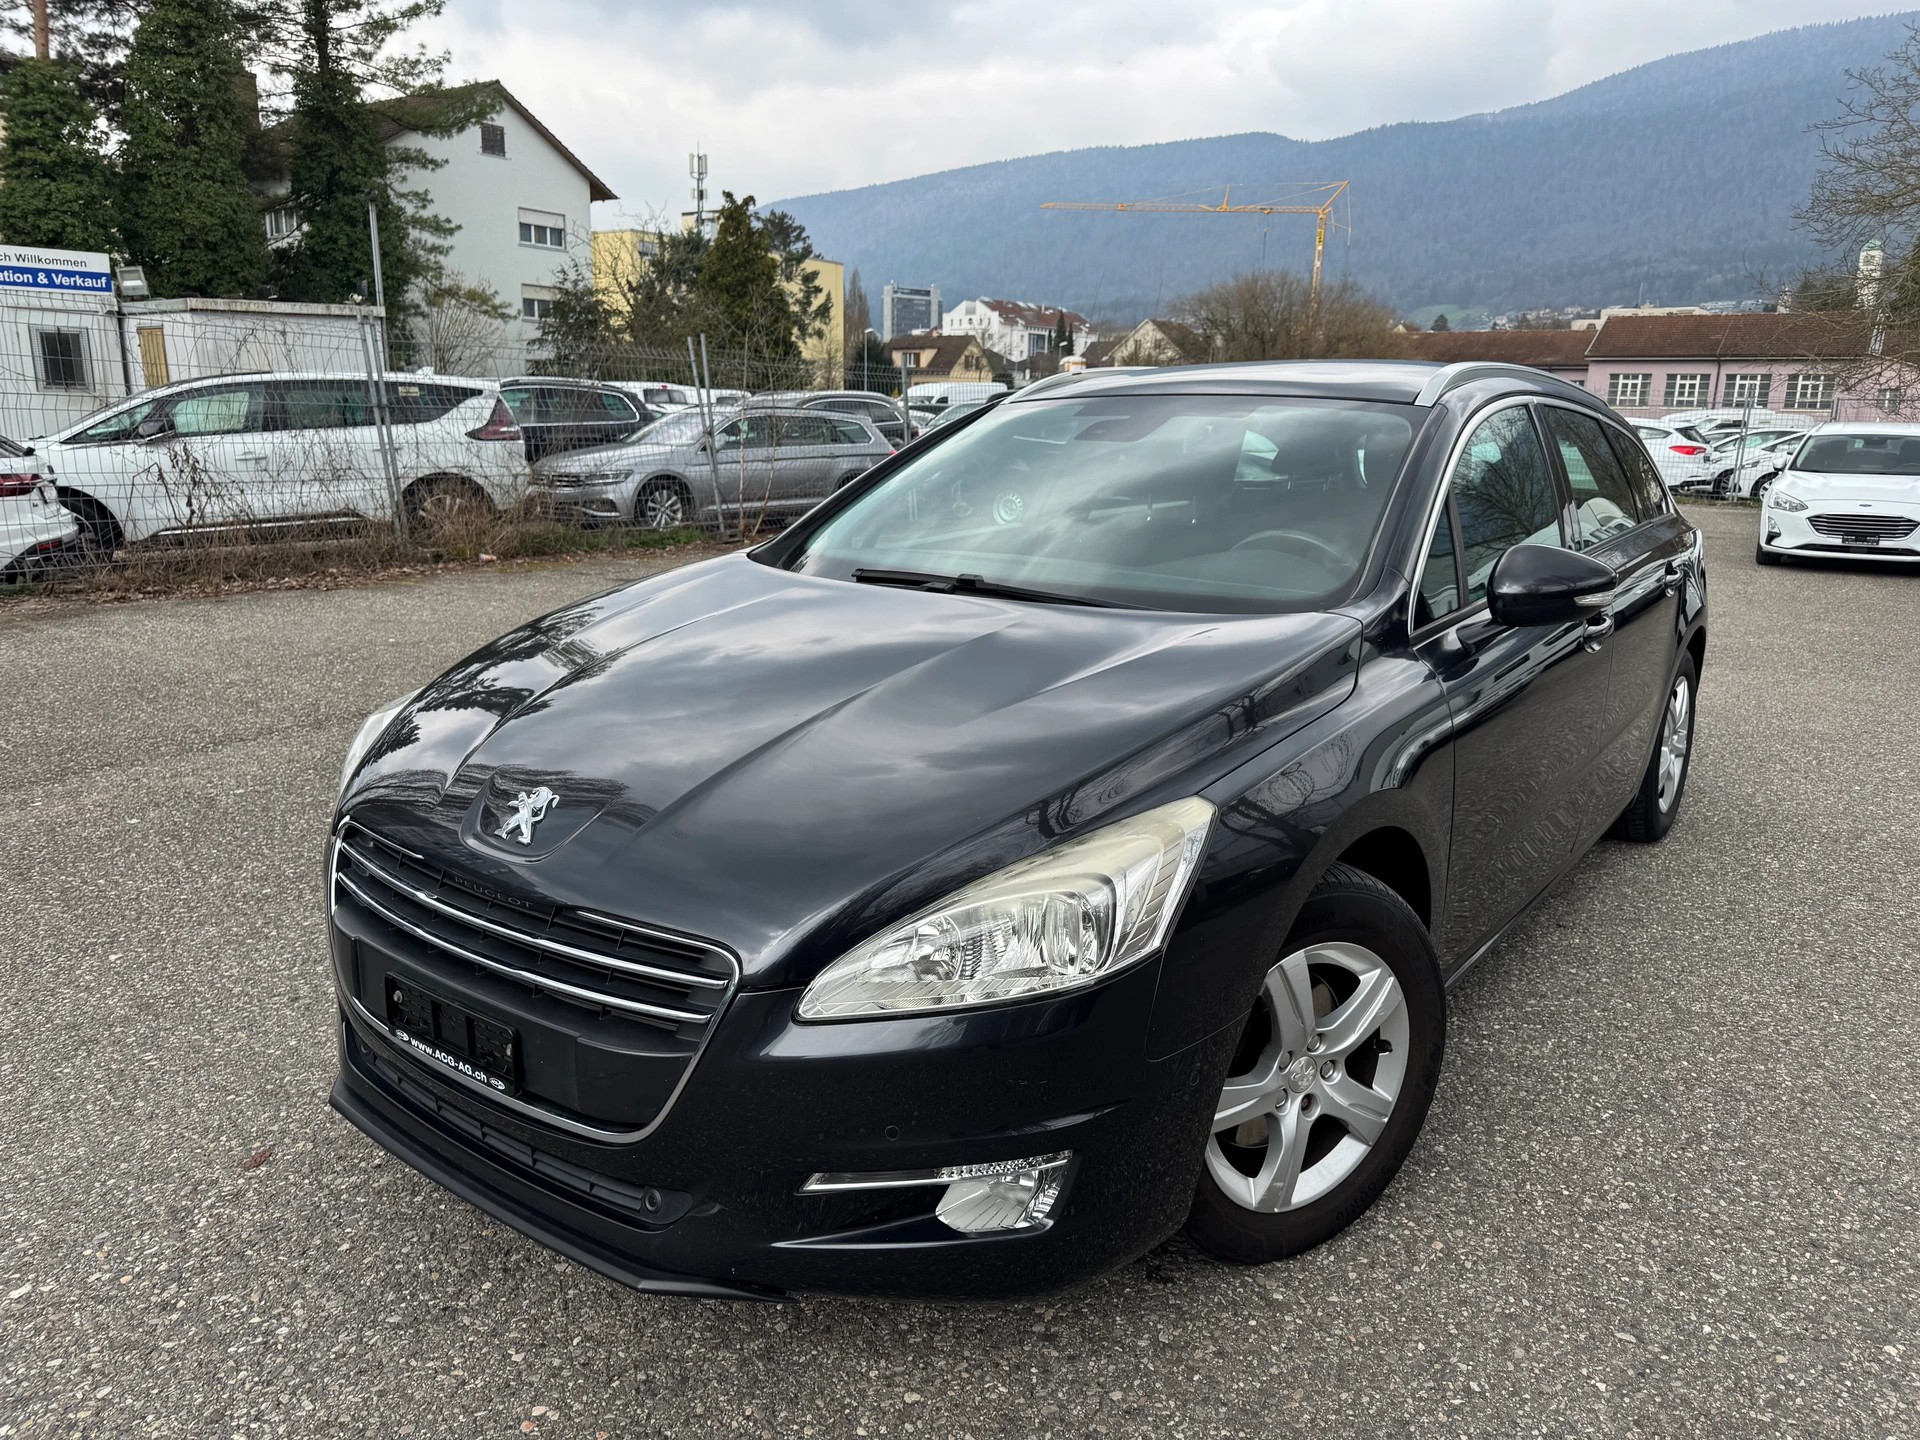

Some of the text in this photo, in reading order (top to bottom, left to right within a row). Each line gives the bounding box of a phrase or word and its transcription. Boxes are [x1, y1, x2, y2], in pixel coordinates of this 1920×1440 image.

[14, 253, 87, 268] Willkommen
[37, 272, 49, 285] &
[51, 273, 107, 289] Verkauf
[455, 876, 533, 907] PEUGEOT
[410, 1037, 488, 1083] www.ACG-AG.ch
